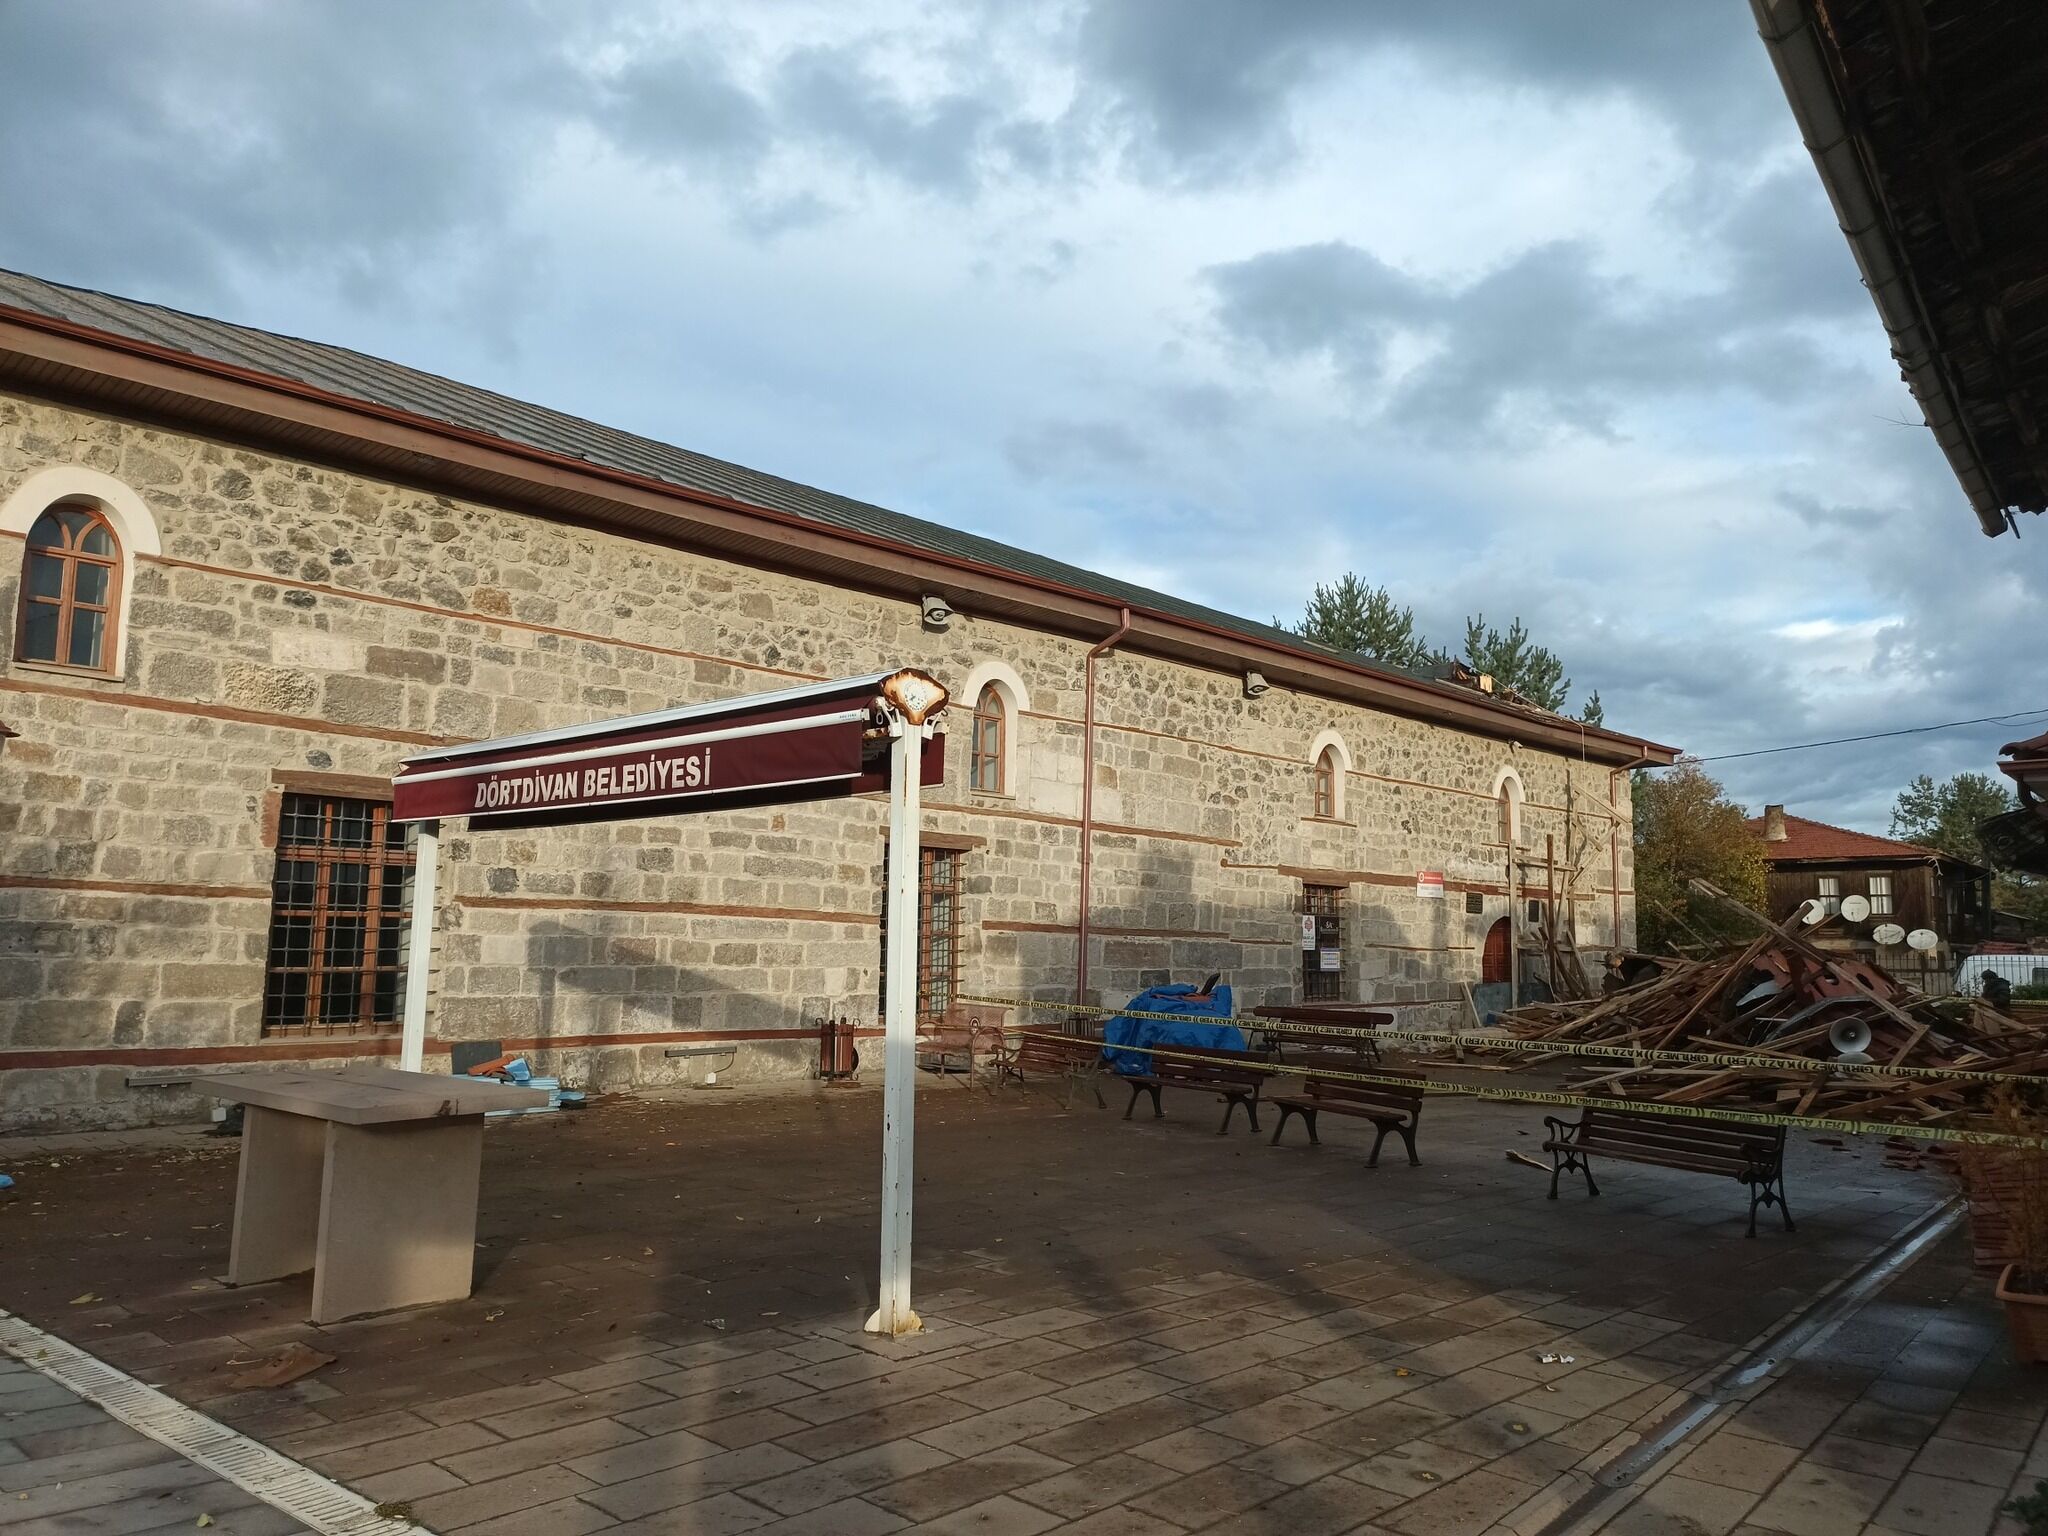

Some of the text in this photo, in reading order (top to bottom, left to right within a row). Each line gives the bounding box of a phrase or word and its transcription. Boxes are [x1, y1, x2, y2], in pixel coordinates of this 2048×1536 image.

[474, 747, 711, 808] DÖRTDİVAN BELEDİYESİ
[1292, 1024, 1311, 1032] KAZA
[1382, 1030, 1406, 1039] KAZA
[1488, 1038, 1513, 1048] KAZA
[1612, 1047, 1642, 1058] KAZA
[1759, 1058, 1795, 1068] KAZA
